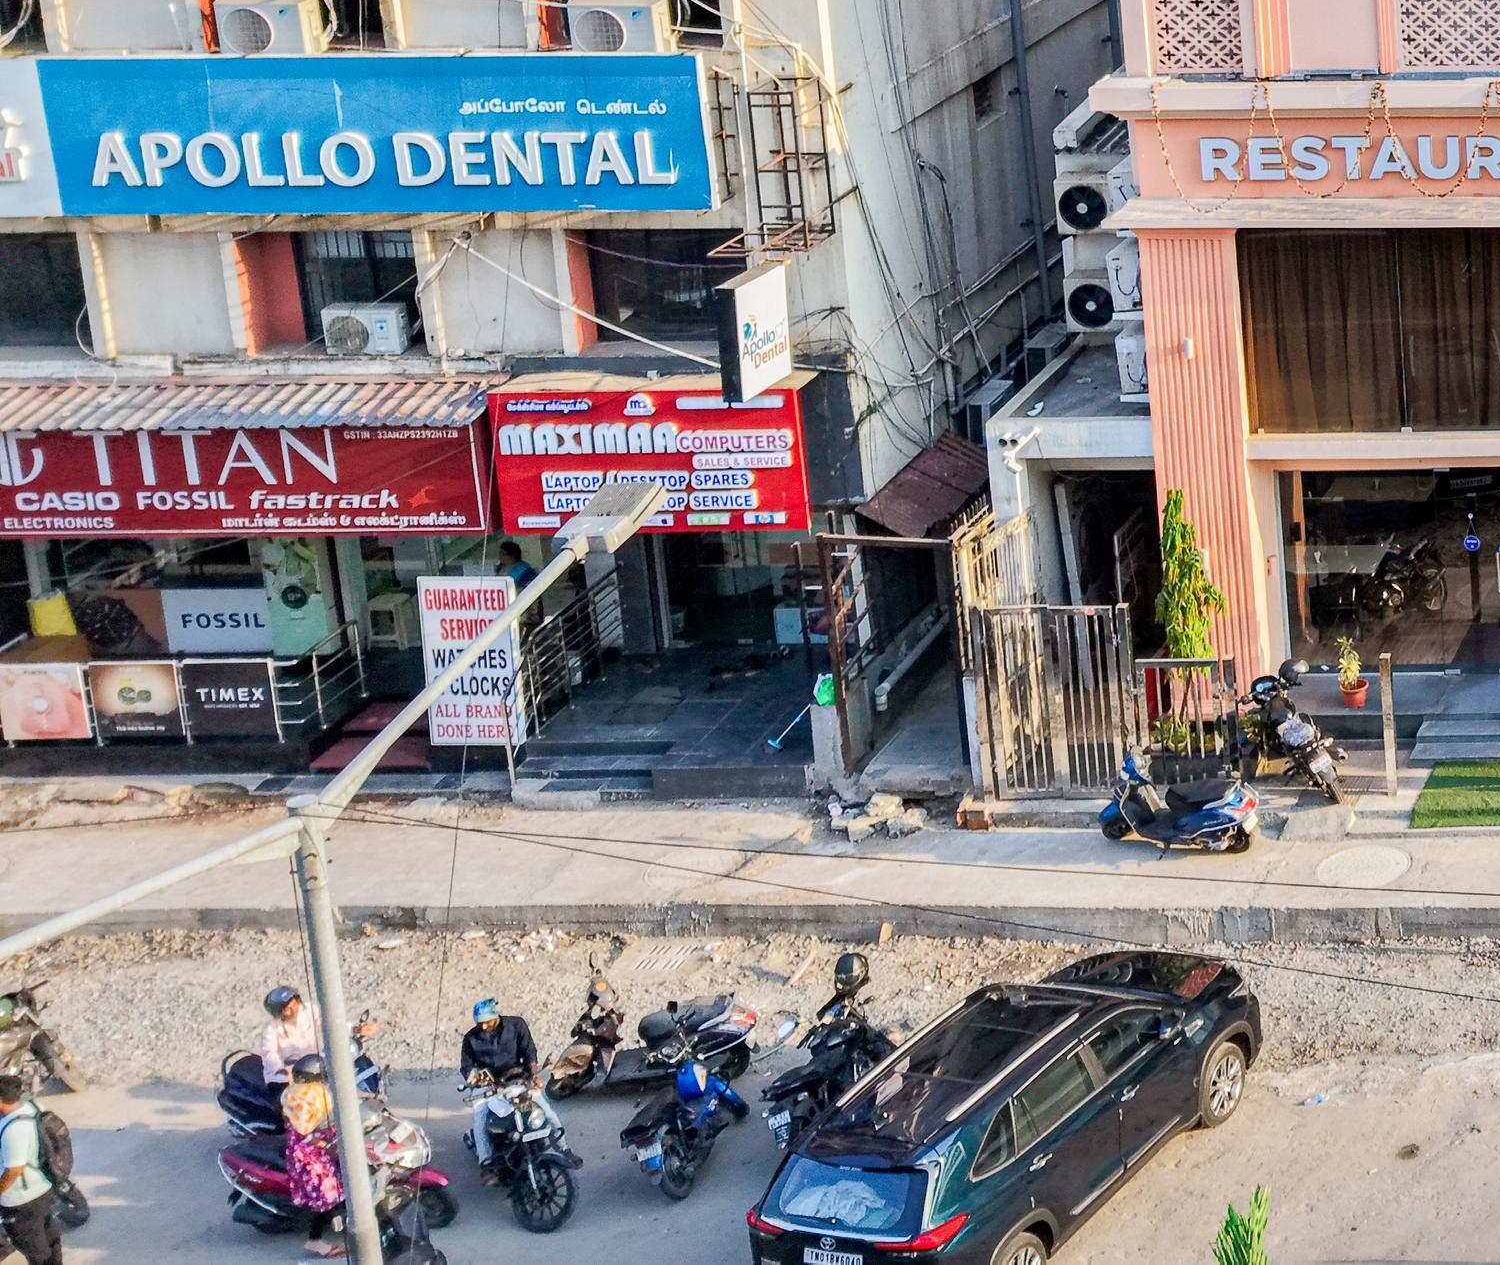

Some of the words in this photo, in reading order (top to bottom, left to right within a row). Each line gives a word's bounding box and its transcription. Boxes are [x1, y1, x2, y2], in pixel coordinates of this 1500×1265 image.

[576, 99, 667, 115] டெண்டல்
[92, 131, 377, 188] APOLLO
[397, 129, 680, 186] DENTAL
[741, 330, 775, 362] Apollo
[754, 335, 787, 368] Dental
[499, 423, 678, 455] MAXIMAA
[679, 432, 790, 451] COMPUTERS
[72, 429, 338, 486] TITAN
[696, 456, 730, 468] SALES
[733, 456, 741, 467] &
[743, 455, 788, 468] SERVICE
[545, 477, 600, 489] LAPTOP
[620, 475, 687, 486] DESKTOP
[694, 472, 750, 486] SPARES
[15, 491, 120, 511] CASIO
[136, 491, 235, 510] FOSSIL
[249, 489, 399, 509] fastrack
[547, 497, 592, 510] LAPTO
[693, 494, 753, 508] SERVICE
[3, 517, 115, 529] ELECTRONICS
[424, 588, 506, 611] GUARANTEED
[182, 613, 265, 628] FOSSIL
[440, 618, 494, 640] SERVIC
[432, 648, 507, 669] WAHES
[196, 687, 265, 702] TIMEX
[450, 676, 512, 696] CLOCKS
[435, 704, 461, 718] ALL
[437, 726, 473, 738] DONE
[477, 725, 514, 738] HERE
